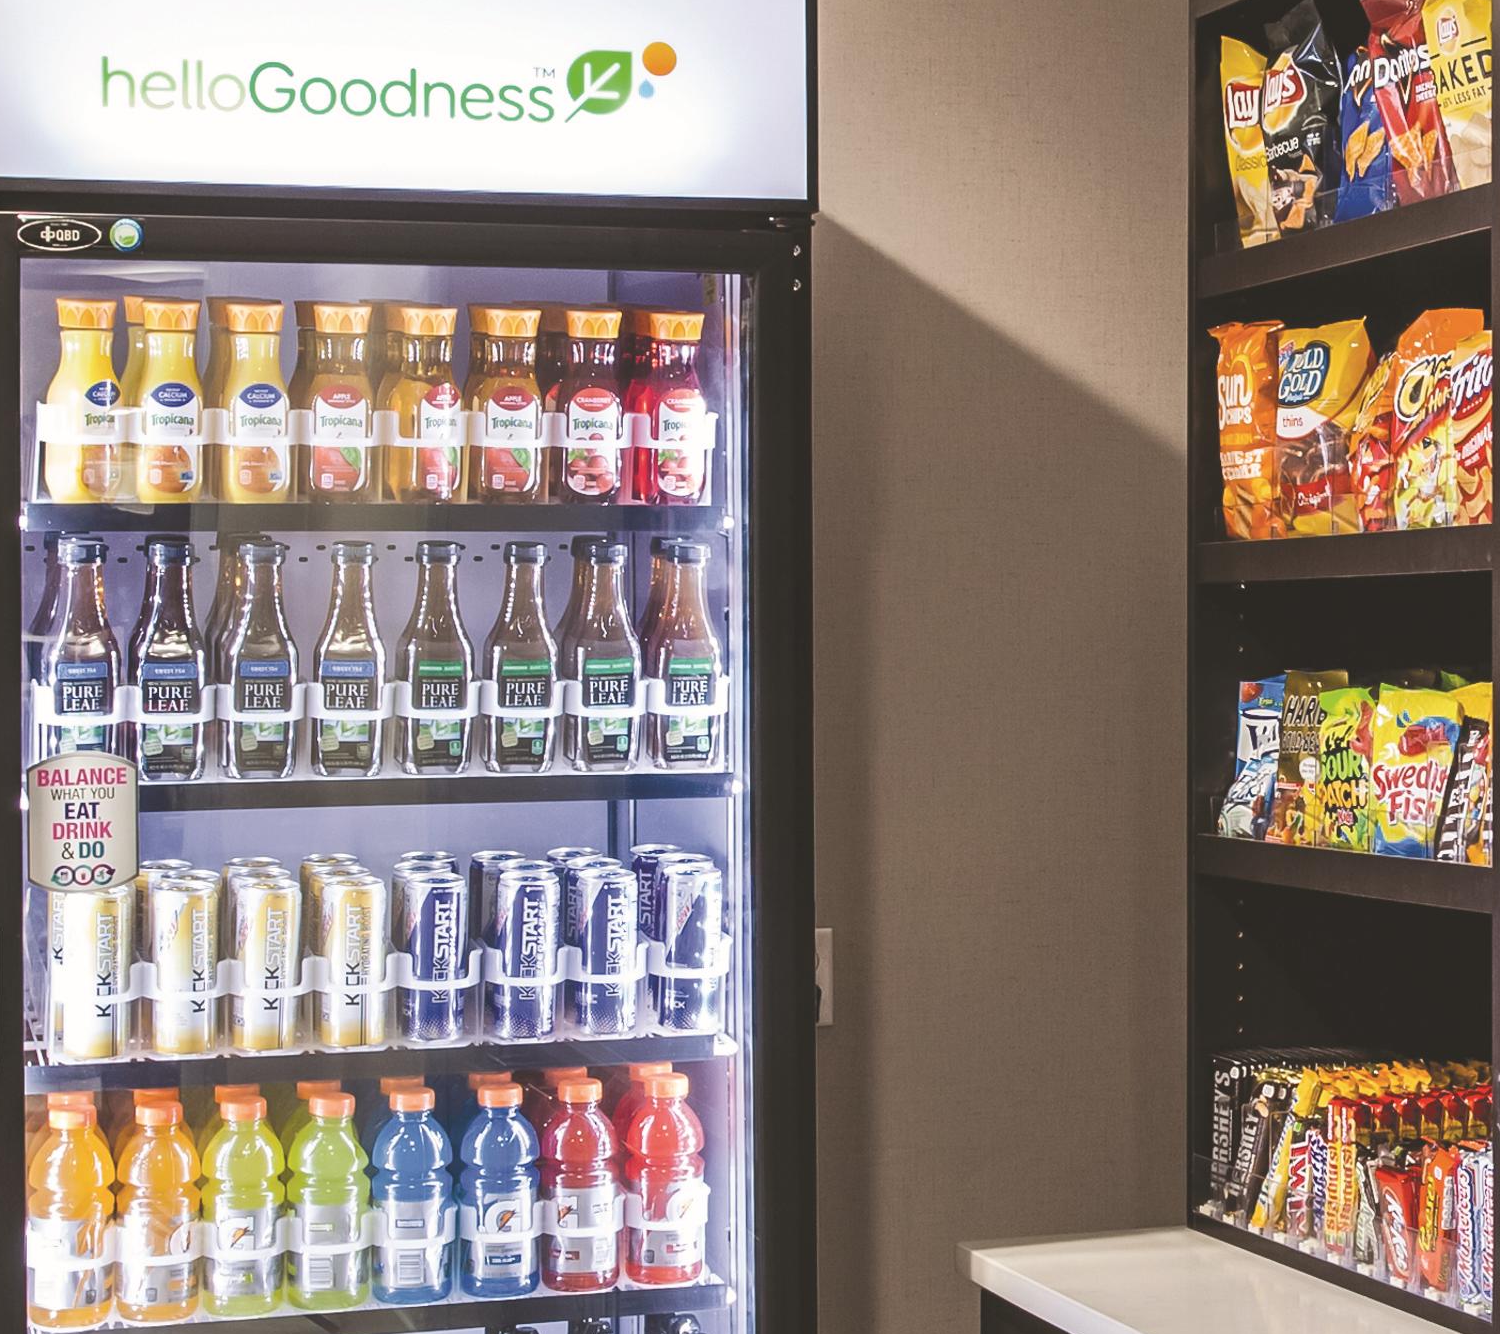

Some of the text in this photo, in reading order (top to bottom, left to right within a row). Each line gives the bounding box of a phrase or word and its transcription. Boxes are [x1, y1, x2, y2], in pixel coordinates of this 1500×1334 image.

[1374, 47, 1430, 88] Doritos
[102, 55, 555, 124] helloGoodness
[1454, 89, 1486, 105] LESS FAT
[151, 415, 194, 426] Tropicana
[241, 415, 282, 428] Tropicana
[320, 416, 362, 428] Tropicana
[492, 418, 532, 429] Tropicana
[1282, 418, 1303, 427] thins
[326, 684, 368, 696] PURE
[422, 683, 458, 695] PURE
[506, 682, 546, 694] PURE
[326, 696, 365, 709] LEAF
[422, 695, 457, 708] LEAF
[506, 694, 541, 706] LEAF
[37, 767, 127, 787] BALANCE
[51, 788, 114, 800] WHAT YOU
[1388, 791, 1436, 825] Fish
[53, 822, 112, 839] DRINK
[62, 841, 104, 859] & DO
